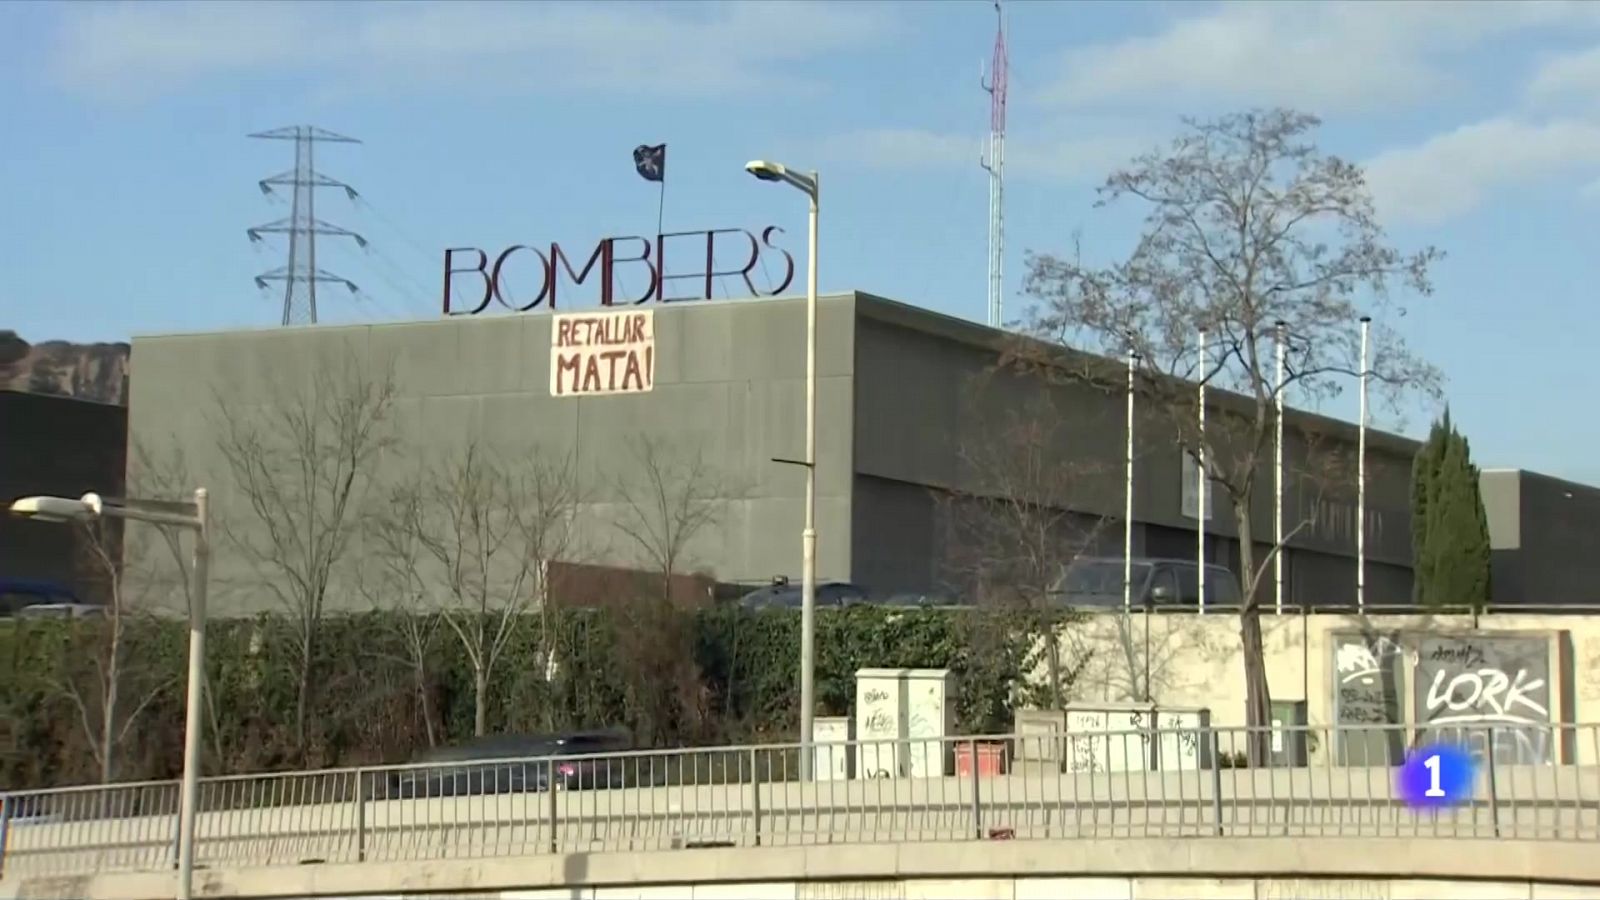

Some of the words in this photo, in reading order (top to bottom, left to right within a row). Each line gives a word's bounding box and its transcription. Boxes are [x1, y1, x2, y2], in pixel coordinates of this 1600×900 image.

[443, 225, 794, 316] BOMBERS
[558, 314, 645, 347] RETALLAR
[557, 346, 652, 394] MATA!
[1426, 668, 1548, 716] LORK
